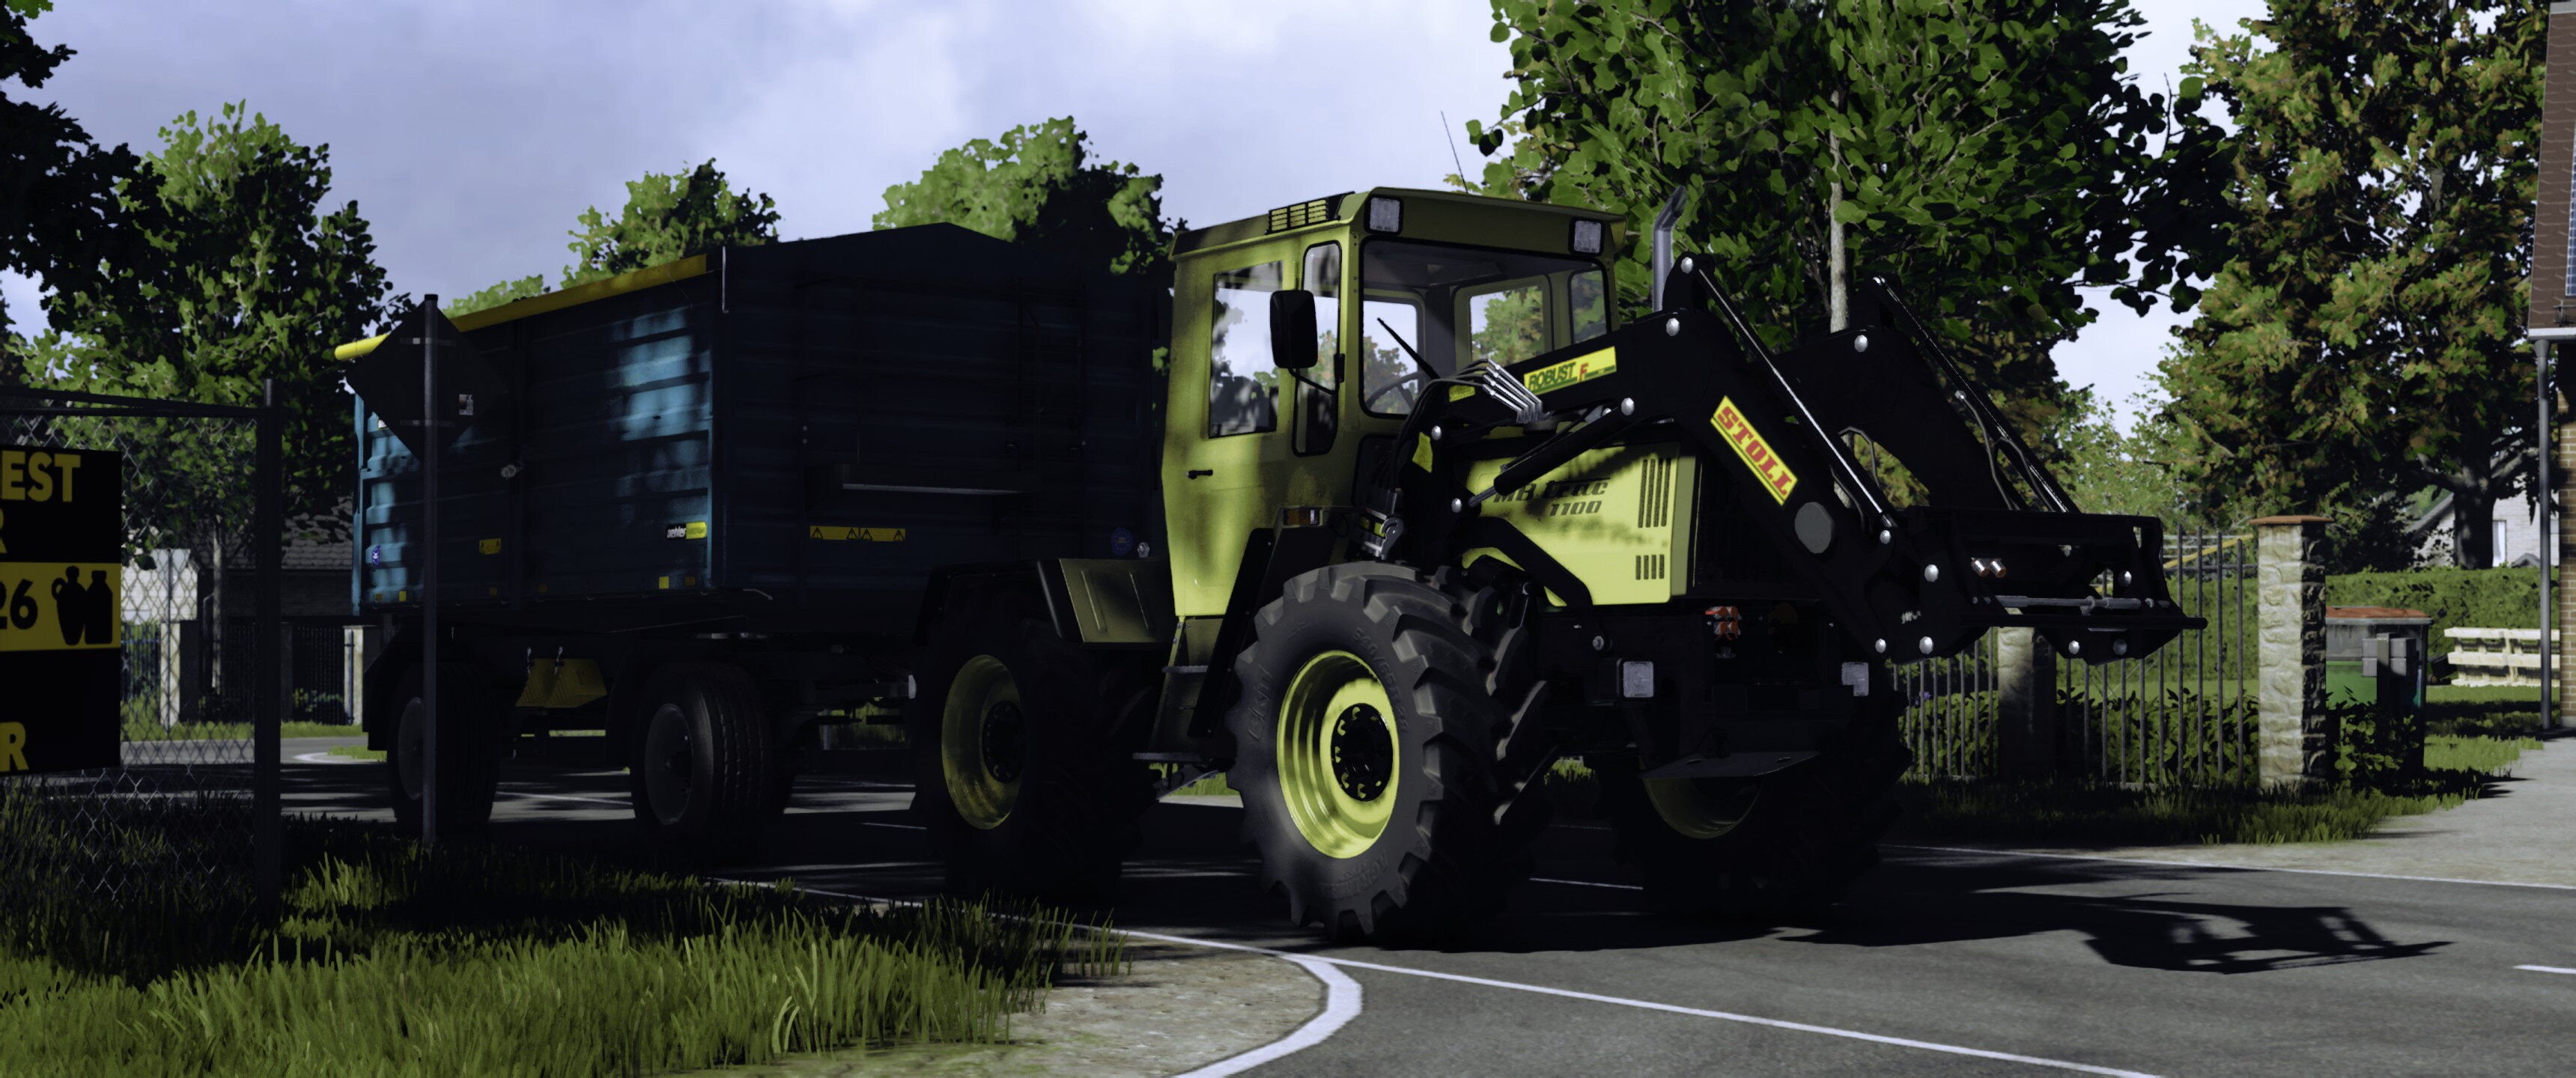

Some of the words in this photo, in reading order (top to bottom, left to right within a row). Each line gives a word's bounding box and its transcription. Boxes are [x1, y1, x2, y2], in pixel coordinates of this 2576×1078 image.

[1528, 362, 1576, 389] ROBUST
[1, 450, 82, 503] EST
[1717, 406, 1792, 496] STOLL
[1550, 501, 1602, 516] 1100
[0, 579, 37, 630] 6
[0, 721, 30, 772] R
